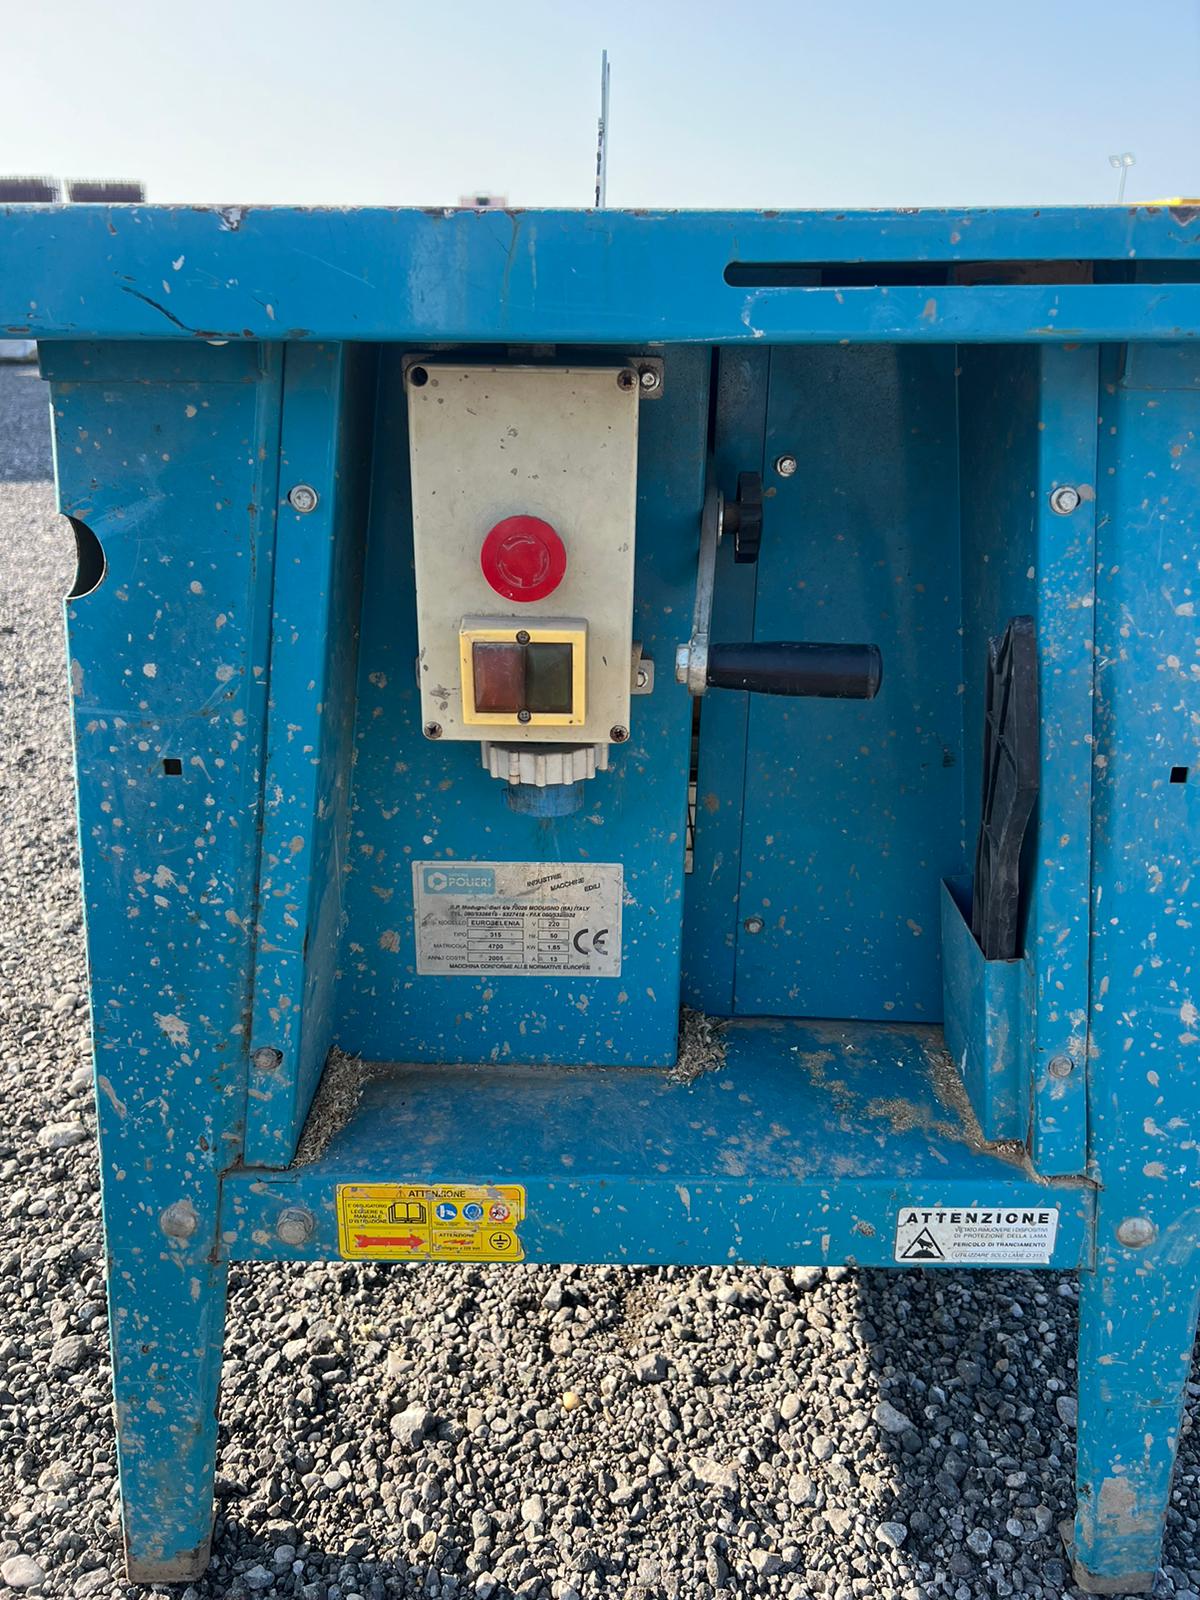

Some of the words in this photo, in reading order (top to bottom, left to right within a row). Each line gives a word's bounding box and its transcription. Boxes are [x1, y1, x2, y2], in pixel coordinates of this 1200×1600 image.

[550, 877, 585, 891] MACCHINE
[584, 883, 601, 892] EDILI
[573, 928, 609, 956] CE
[906, 1212, 1050, 1224] ATTENZIONE
